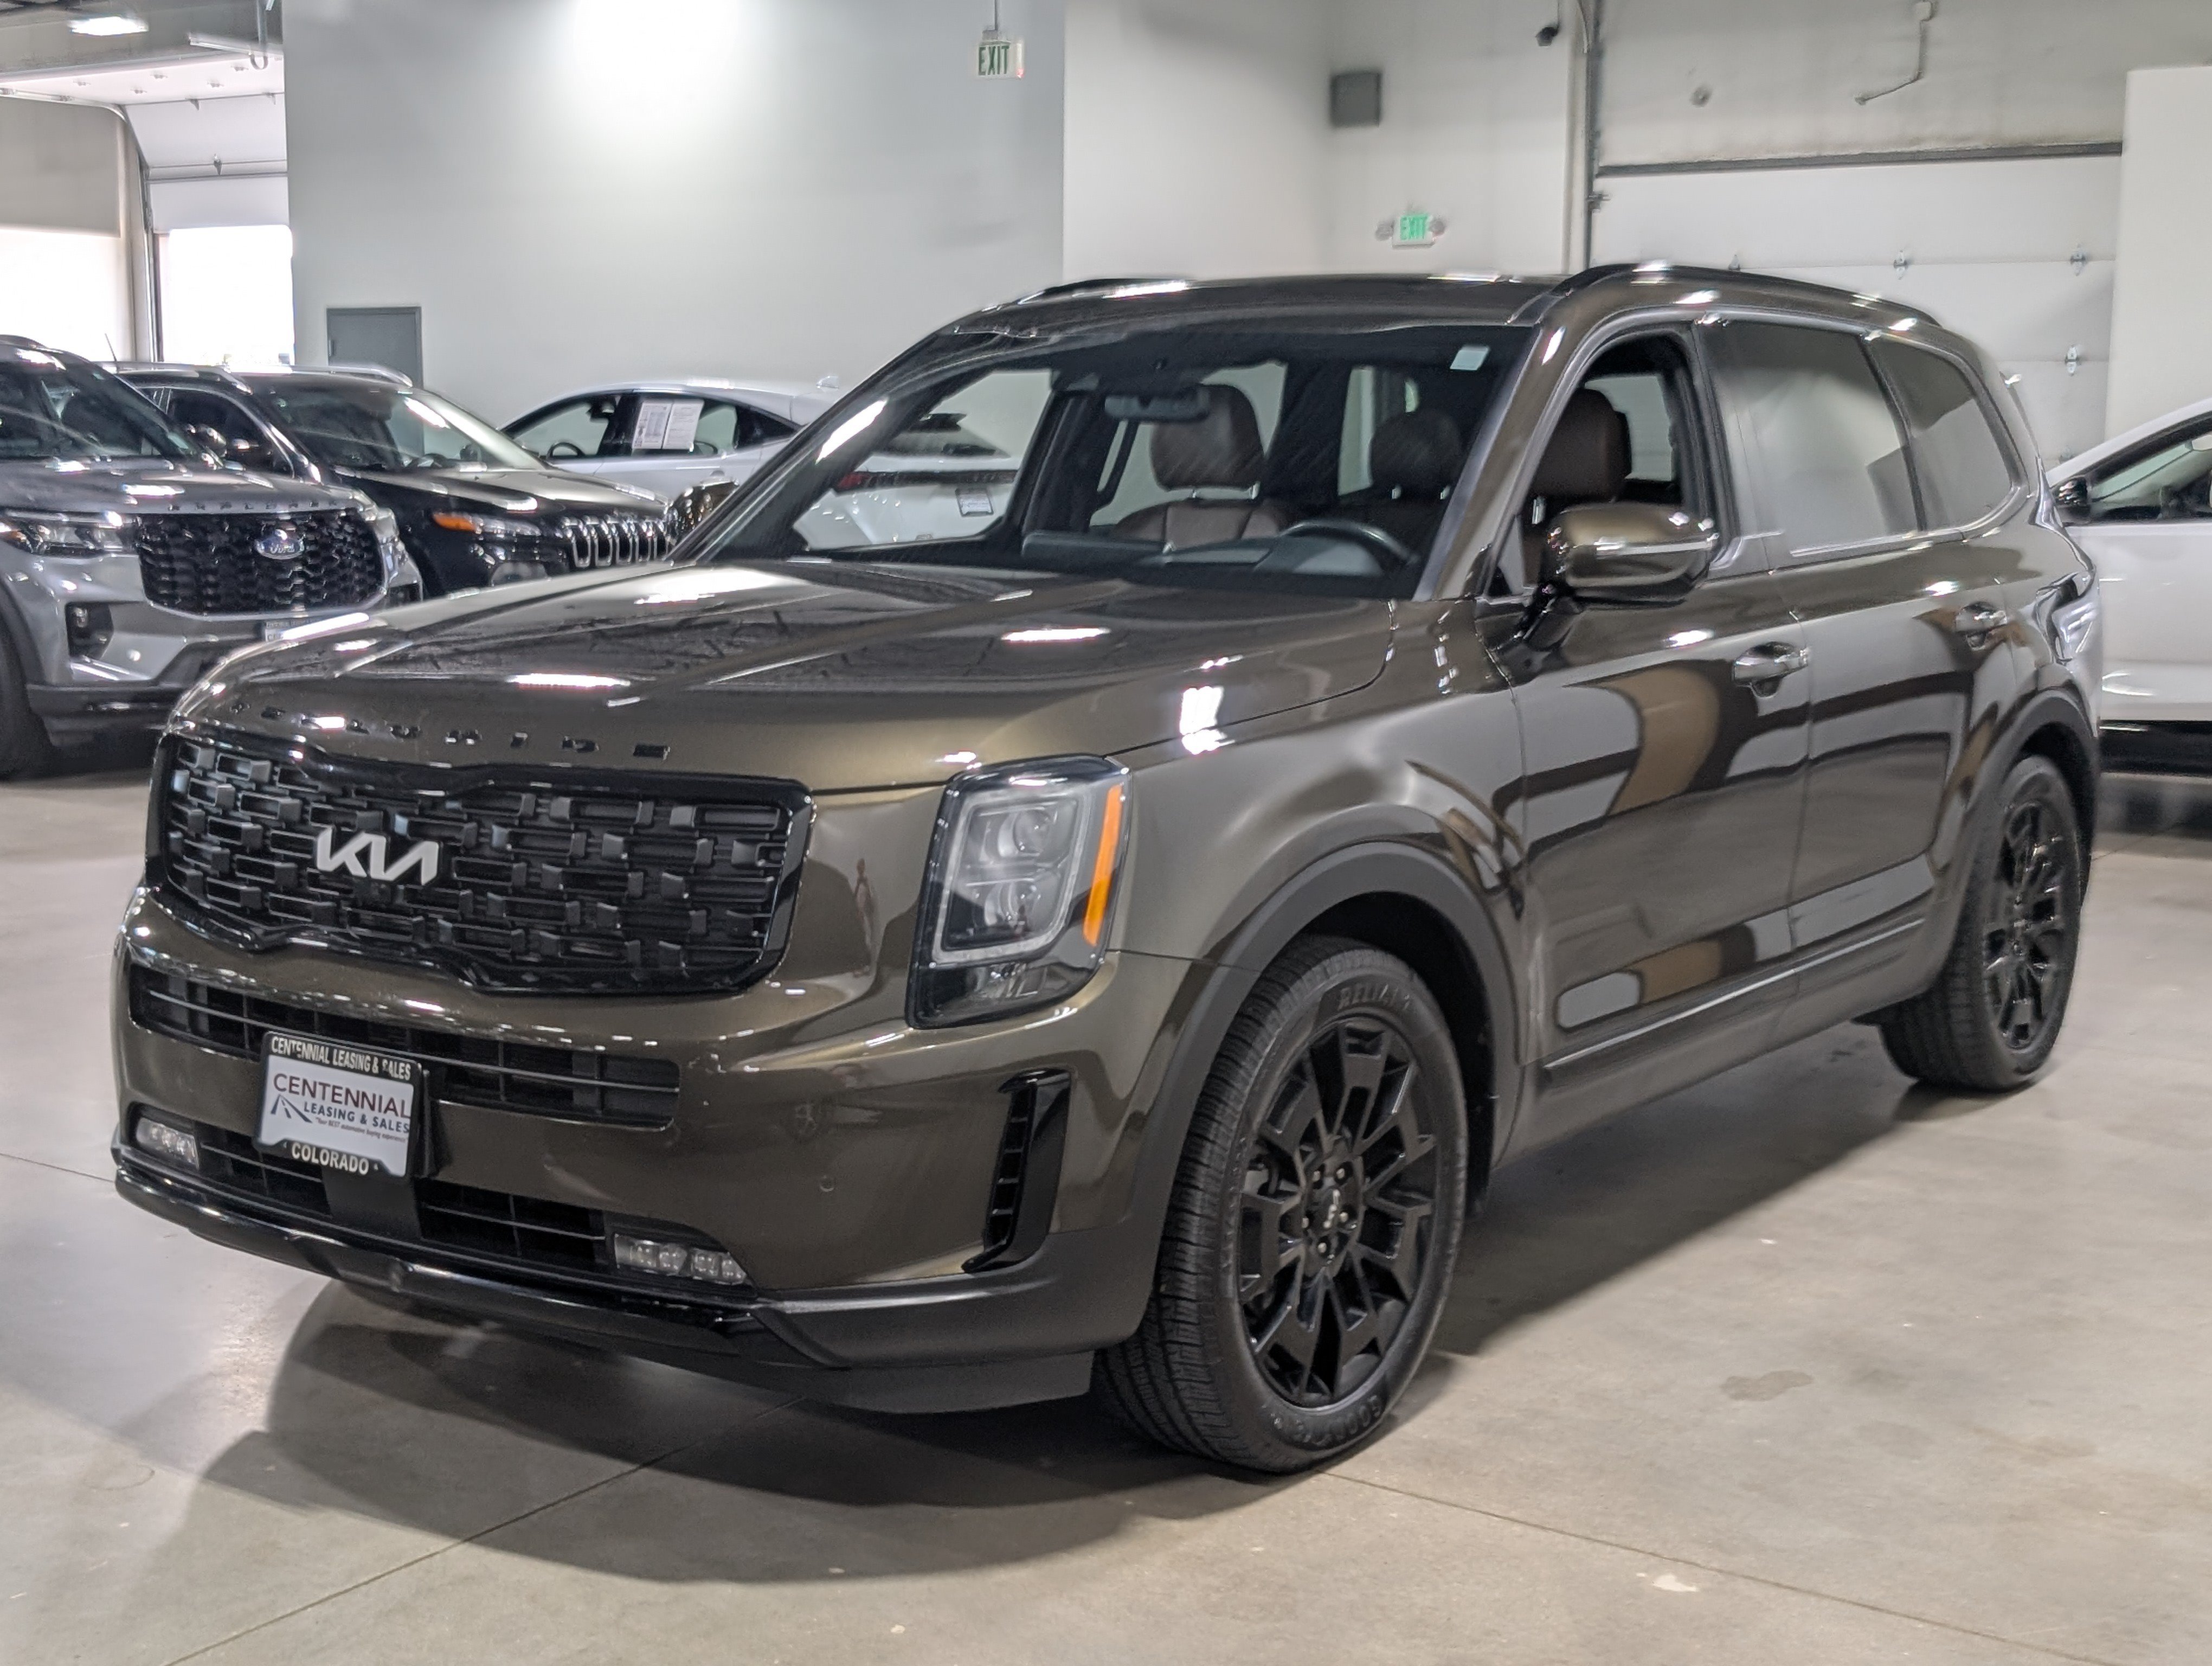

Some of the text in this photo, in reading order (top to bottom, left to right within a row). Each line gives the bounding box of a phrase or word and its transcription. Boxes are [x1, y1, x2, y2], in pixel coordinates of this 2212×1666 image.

[978, 46, 1009, 75] EXIT
[1400, 214, 1429, 240] EXIT
[317, 826, 439, 886] KIA
[271, 1036, 411, 1081] CENTENNIAL LEASING & SALES
[273, 1073, 411, 1119] CENTENNIAL
[304, 1101, 410, 1134] LEASING & SALES
[291, 1142, 370, 1176] COLORADO
